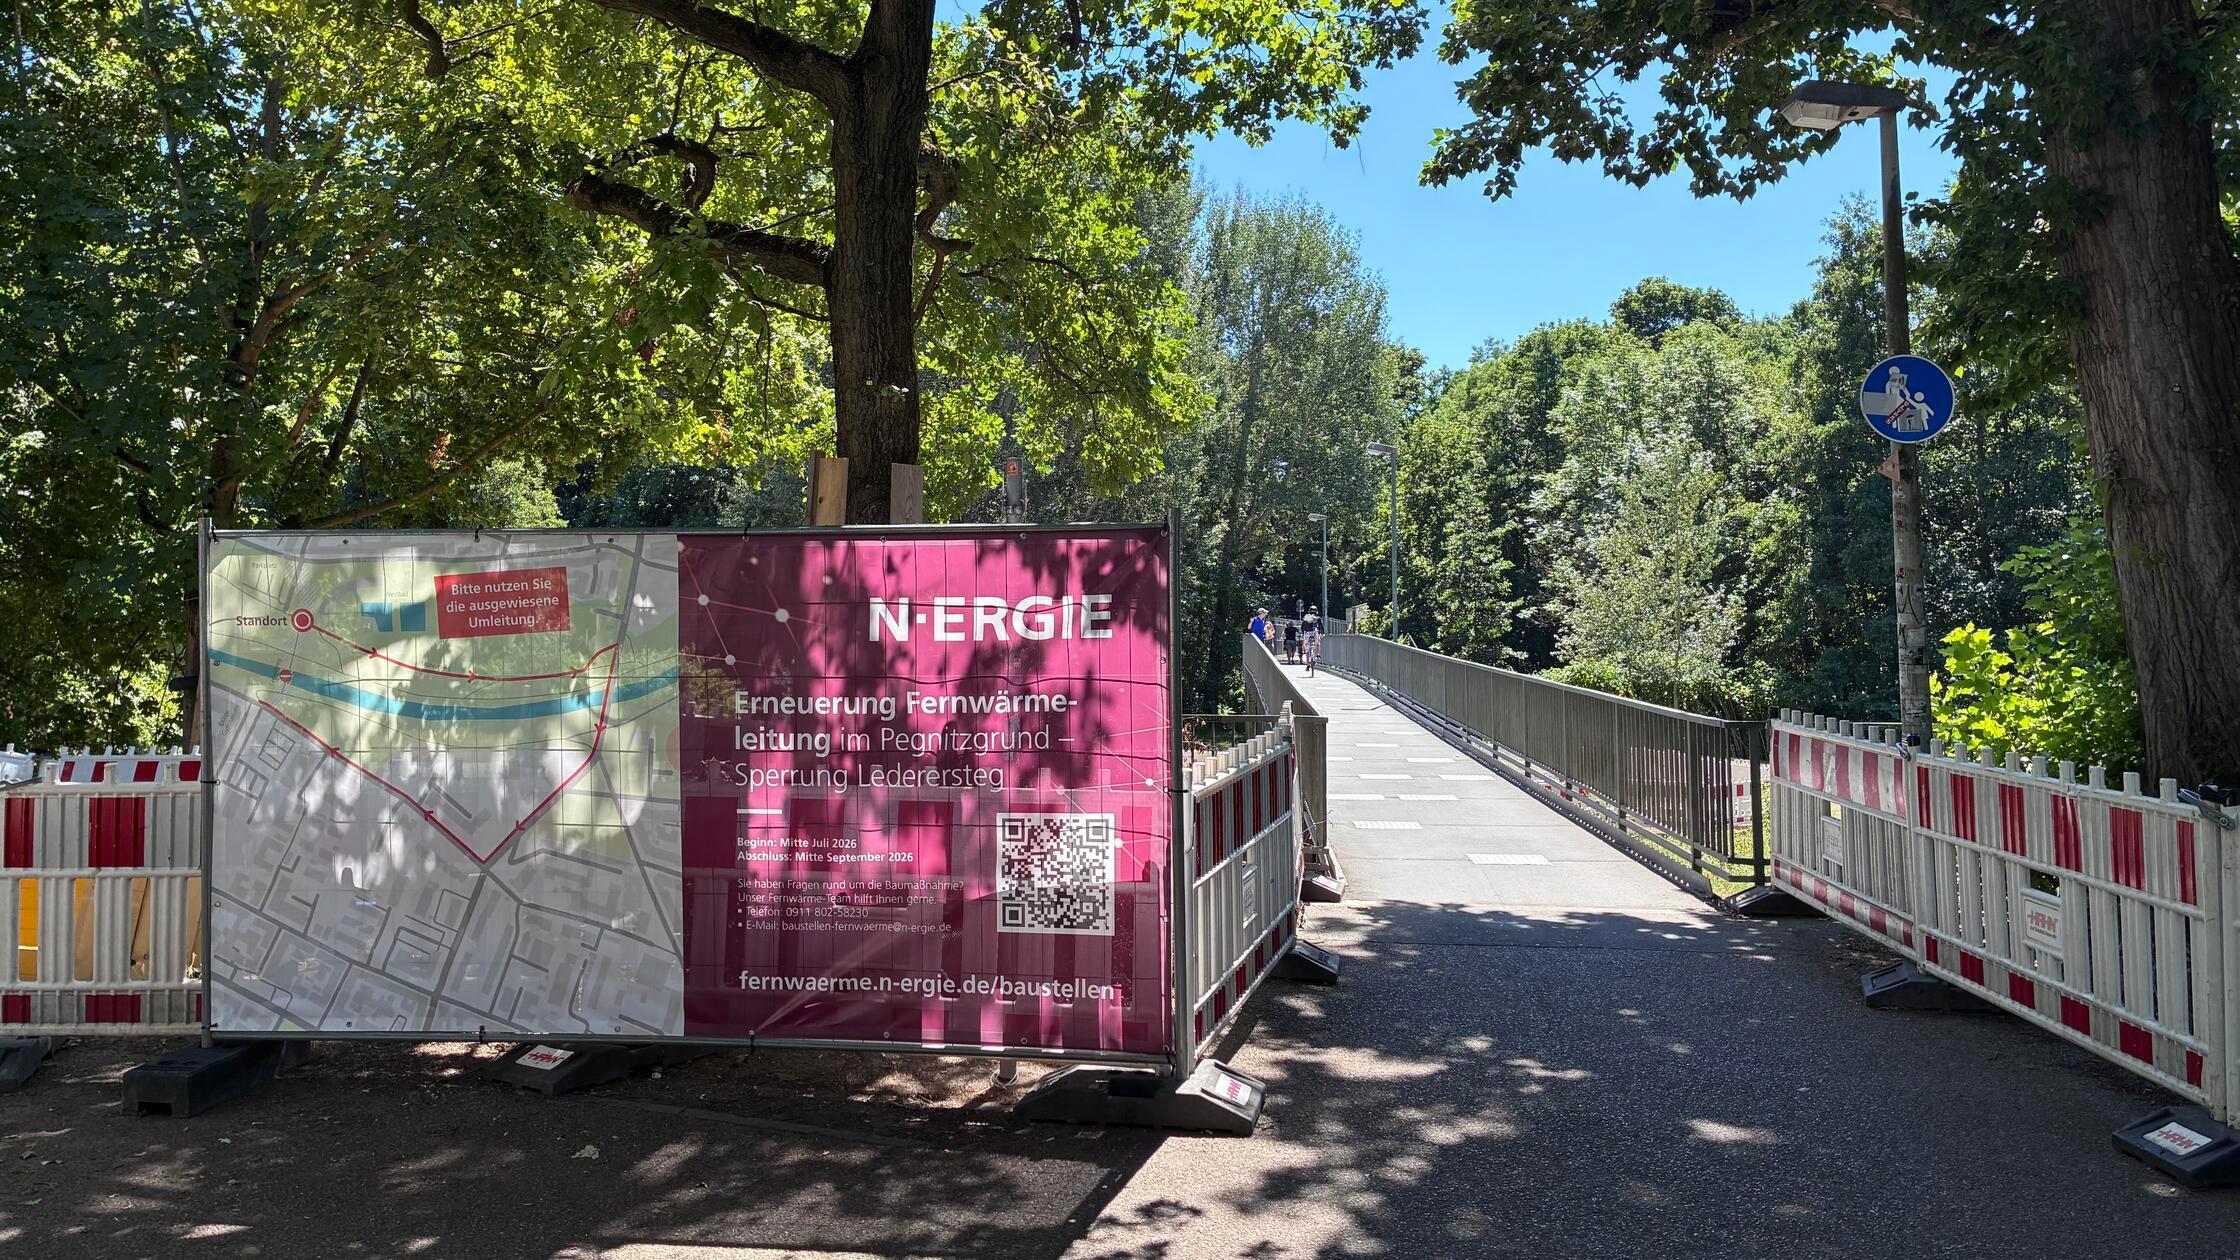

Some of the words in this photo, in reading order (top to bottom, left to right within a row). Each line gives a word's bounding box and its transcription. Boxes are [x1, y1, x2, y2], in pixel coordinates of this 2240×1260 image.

[451, 583, 481, 596] Bitte
[484, 581, 529, 593] nutzen
[532, 578, 552, 590] Sie
[446, 601, 465, 613] die
[469, 596, 559, 614] ausgewiesene
[236, 616, 288, 626] Standort
[468, 613, 539, 630] Umleitung.
[735, 691, 896, 721] Erneuerung
[907, 690, 1077, 714] Fernwärme-
[735, 726, 831, 757] leitung
[840, 726, 870, 751] im
[881, 724, 1050, 757] Pegnitzgrund
[735, 763, 848, 793] Sperrung
[858, 763, 1004, 792] Lederersteg
[737, 838, 777, 849] Beginn:
[780, 838, 809, 848] Mitte
[811, 838, 829, 848] Juli
[832, 838, 857, 849] 2026
[737, 851, 792, 861] Abschluss:
[795, 852, 824, 862] Mitte
[826, 852, 885, 864] September
[888, 852, 914, 862] 2026
[737, 879, 751, 889] Sie
[754, 879, 784, 889] haben
[787, 880, 820, 891] Fragen
[822, 880, 846, 889] rund
[849, 881, 865, 889] um
[867, 880, 883, 890] die
[885, 880, 964, 891] Baumaßnahme?
[737, 893, 765, 903] Unser
[854, 894, 873, 904] hilft
[876, 894, 904, 904] Ihnen
[907, 895, 937, 906] gerne.
[747, 907, 782, 917] Telefon:
[786, 907, 810, 917] 0911
[815, 908, 869, 918] 802-58230
[746, 920, 779, 931] E-Mail:
[782, 921, 951, 935] baustellen-fernwaerme@n-ergie.de
[739, 970, 1115, 1000] fernwaerme.n-ergie.de/baustellen
